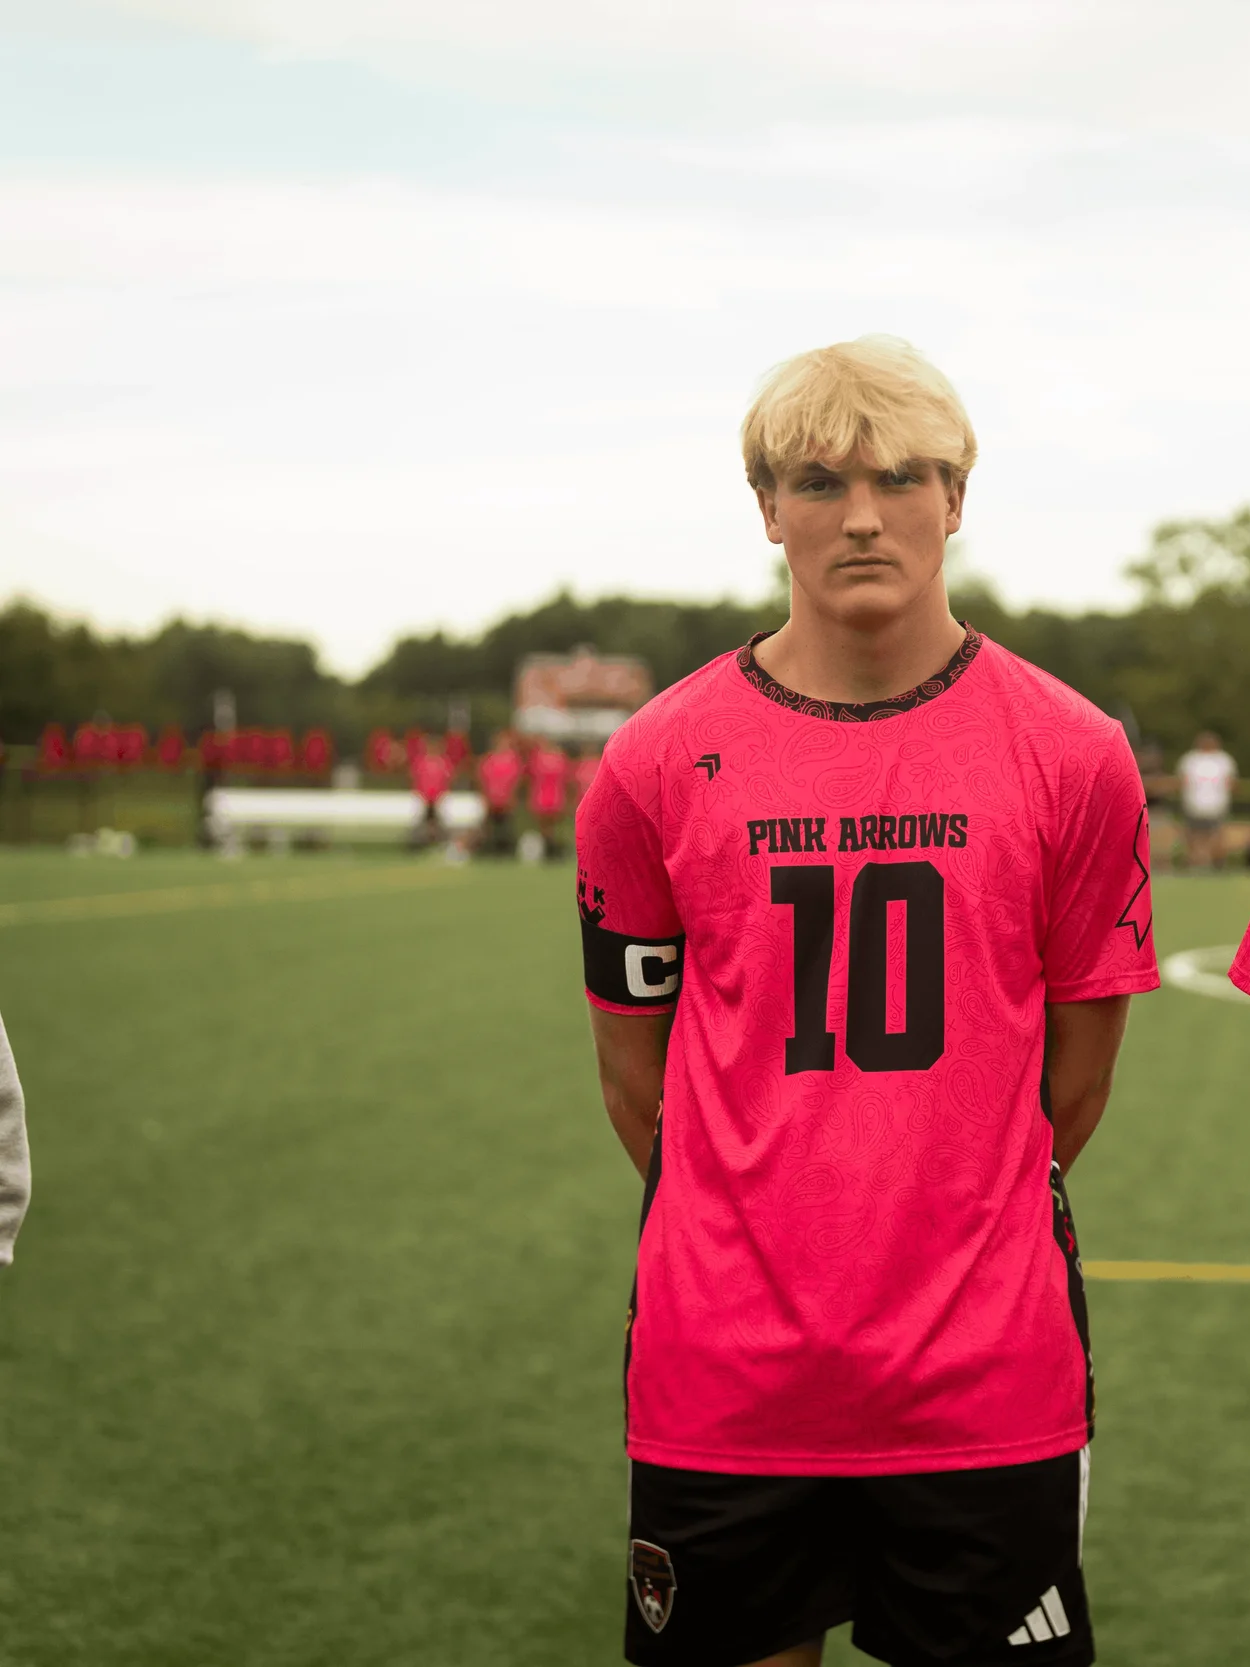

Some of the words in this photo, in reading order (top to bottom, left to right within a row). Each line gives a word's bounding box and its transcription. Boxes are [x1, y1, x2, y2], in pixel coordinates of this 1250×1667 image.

[747, 817, 827, 855] PINK
[838, 814, 968, 852] ARROWS
[578, 878, 606, 905] NK
[625, 944, 679, 998] C
[770, 861, 945, 1076] 10
